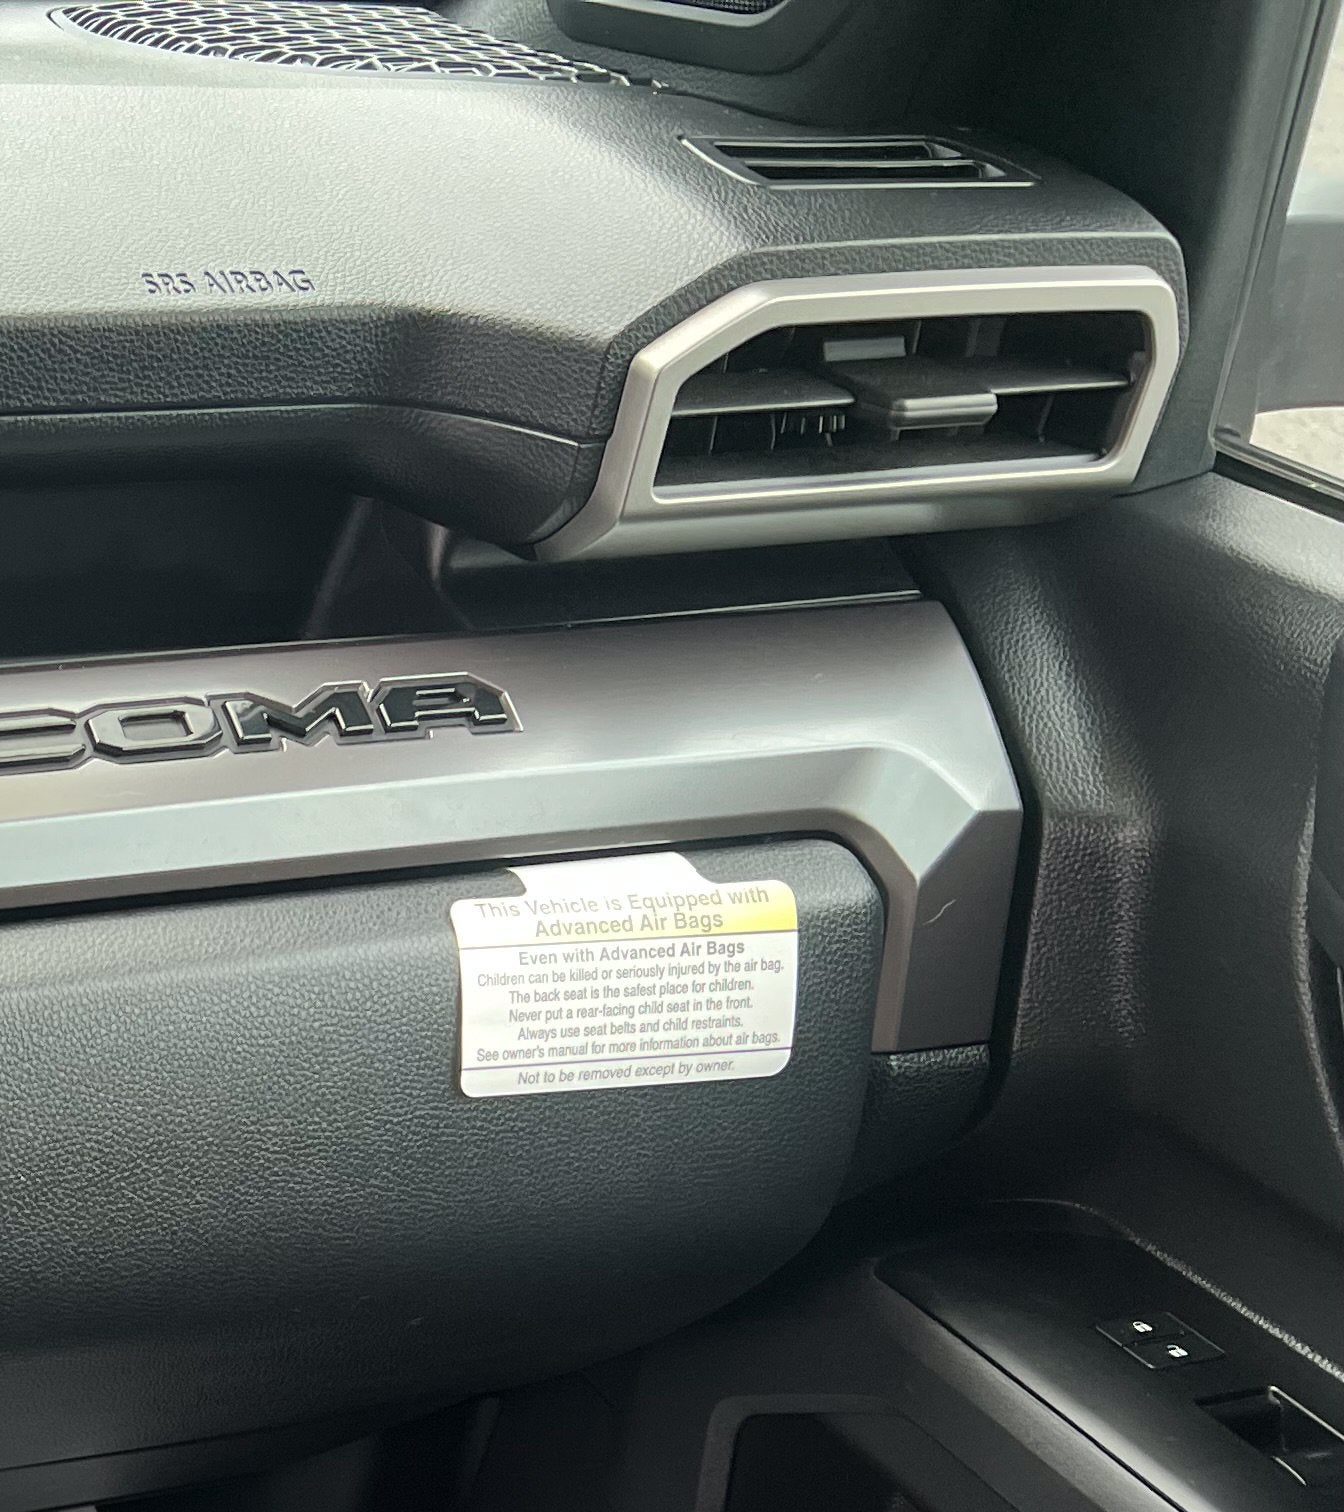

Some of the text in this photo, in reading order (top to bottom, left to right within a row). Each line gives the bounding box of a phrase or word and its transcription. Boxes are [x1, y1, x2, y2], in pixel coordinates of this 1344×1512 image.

[141, 269, 315, 294] SRS AIRBAG
[474, 887, 770, 918] This Vehicle is Equipped with
[535, 912, 724, 937] Advanced Air Bags
[519, 941, 745, 965] Even with Advanced Air Bags
[477, 958, 784, 987] Children can be killed or seriously injured by the air bag.
[509, 978, 754, 1003] The back seat is the safest place for children.
